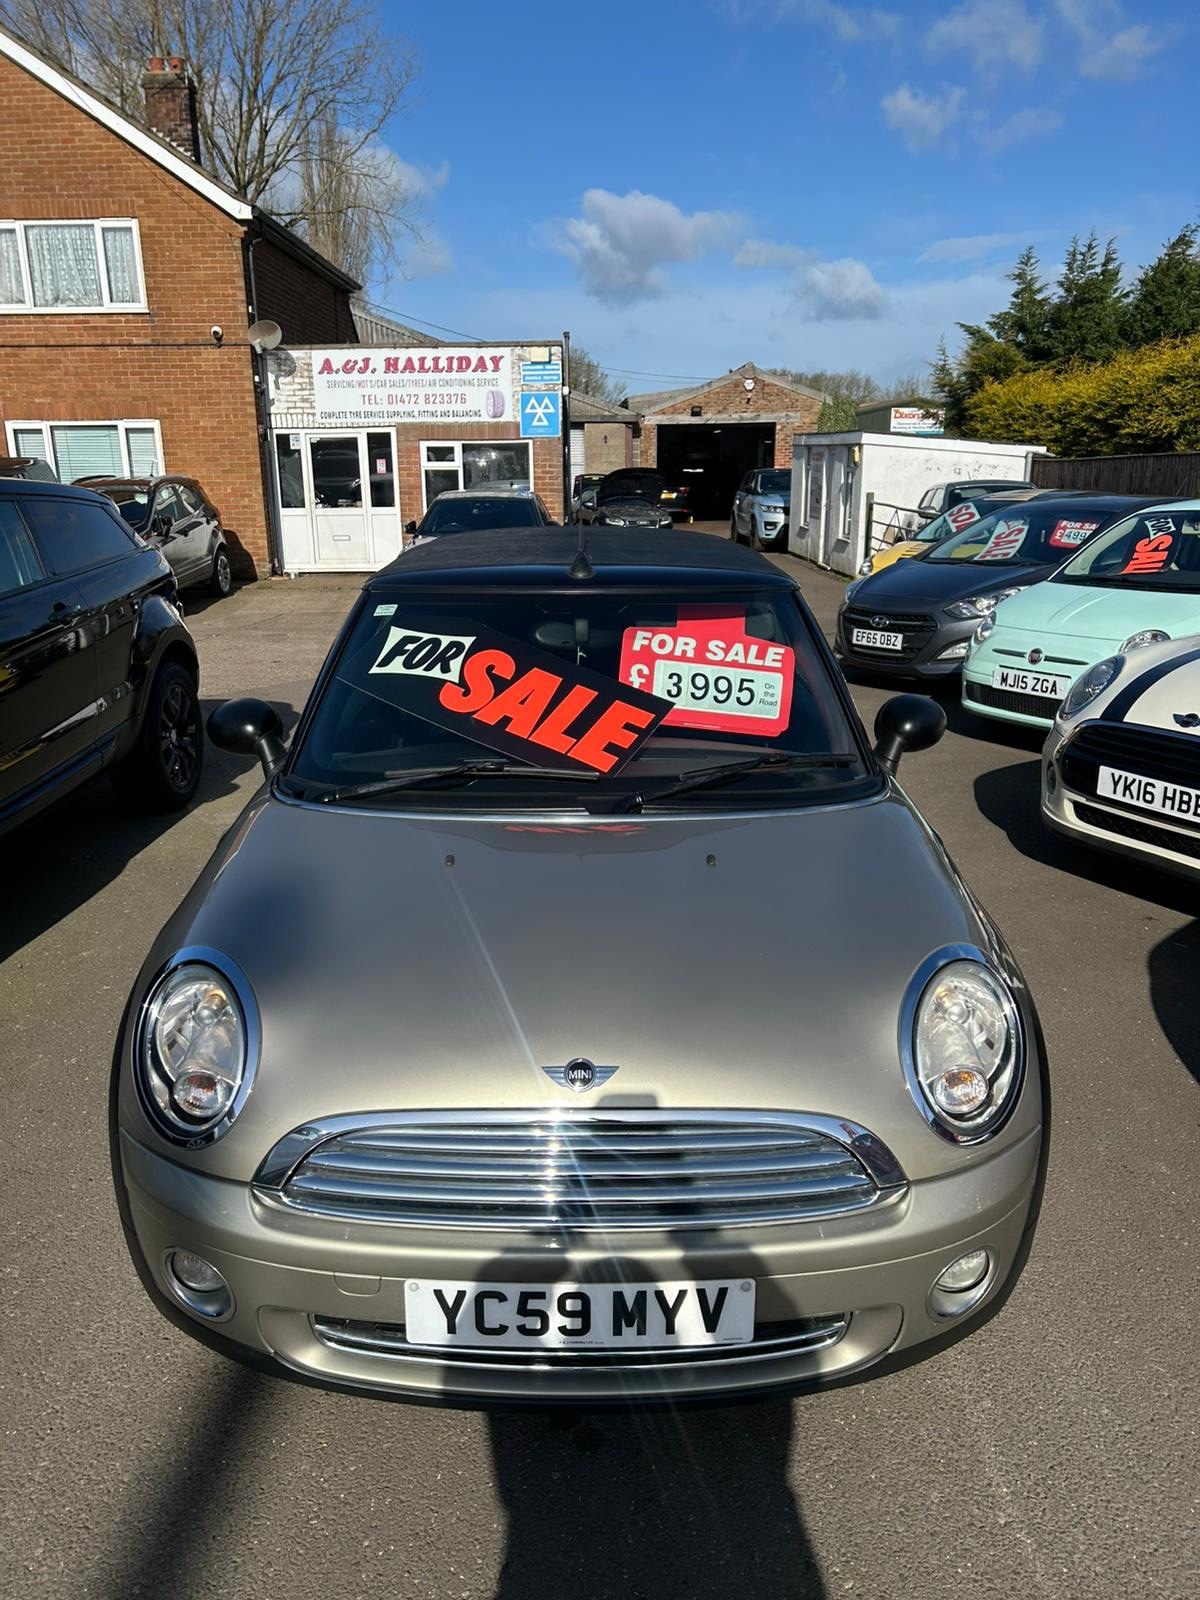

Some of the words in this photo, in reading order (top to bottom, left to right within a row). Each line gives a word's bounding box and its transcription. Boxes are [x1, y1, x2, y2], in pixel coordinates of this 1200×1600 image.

[384, 355, 505, 374] HALLIDAY
[438, 378, 476, 388] CONDITIONING
[477, 377, 499, 387] SERVICE
[361, 394, 384, 406] TEL:
[387, 393, 420, 405] 01472
[424, 392, 467, 405] 823376
[320, 411, 347, 420] COMPLETE
[349, 411, 362, 419] TYRE
[363, 410, 385, 419] SERVICE
[386, 410, 418, 420] SUPPLYING,
[418, 410, 439, 418] FITTING
[440, 410, 450, 418] AND
[452, 409, 482, 418] BALANCING
[1060, 520, 1081, 529] FOR
[1065, 530, 1087, 541] 499
[856, 630, 878, 645] EF65
[879, 633, 899, 647] OBZ
[632, 630, 697, 658] FOR
[705, 639, 785, 668] SALE
[628, 663, 650, 689] £
[666, 672, 756, 707] 3995
[764, 682, 776, 690] On
[1000, 671, 1029, 690] MJ15
[1031, 676, 1058, 696] ZGA
[376, 635, 466, 674] FOR
[439, 649, 656, 774] SALE
[758, 697, 778, 707] Road
[1111, 772, 1156, 805] YK16
[568, 1069, 592, 1080] MINI
[433, 1288, 592, 1337] YC59
[612, 1286, 729, 1337] MYV
